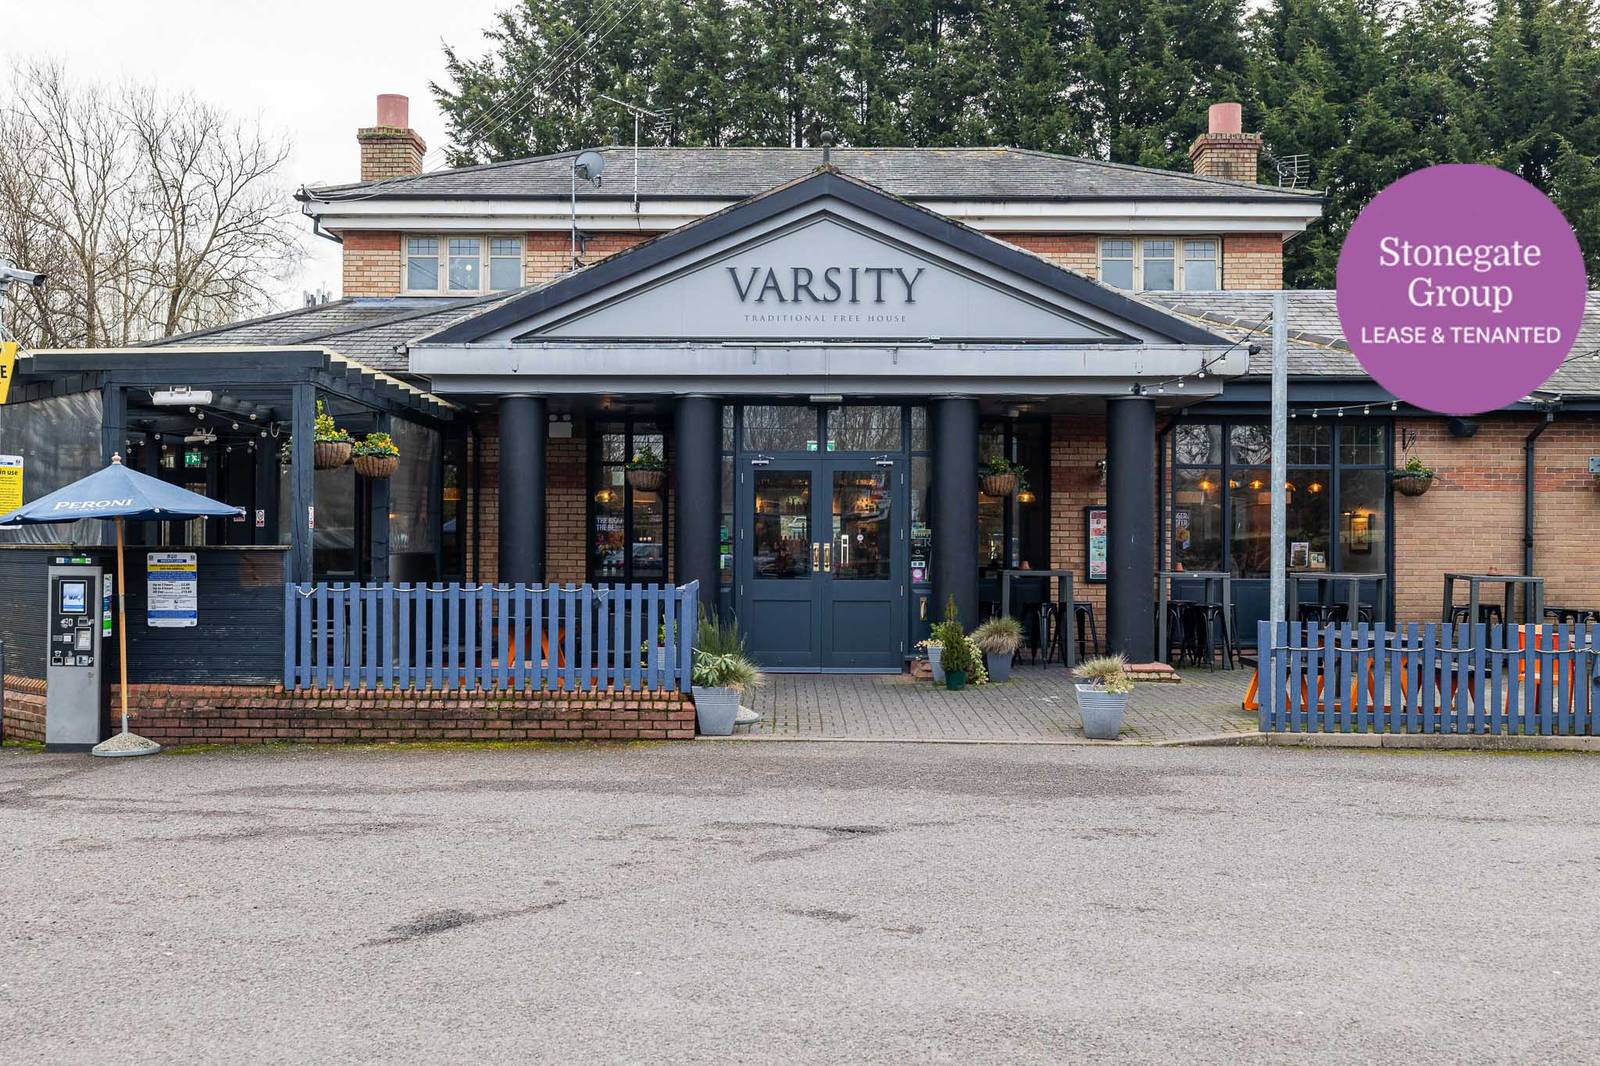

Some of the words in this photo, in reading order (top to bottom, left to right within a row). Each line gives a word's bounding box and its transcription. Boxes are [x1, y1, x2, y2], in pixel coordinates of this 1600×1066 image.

[726, 266, 926, 304] VARSITY
[744, 314, 826, 323] TRADITIONAL
[833, 315, 860, 323] FREE
[868, 315, 906, 323] HOUSE
[54, 498, 134, 510] PERONI
